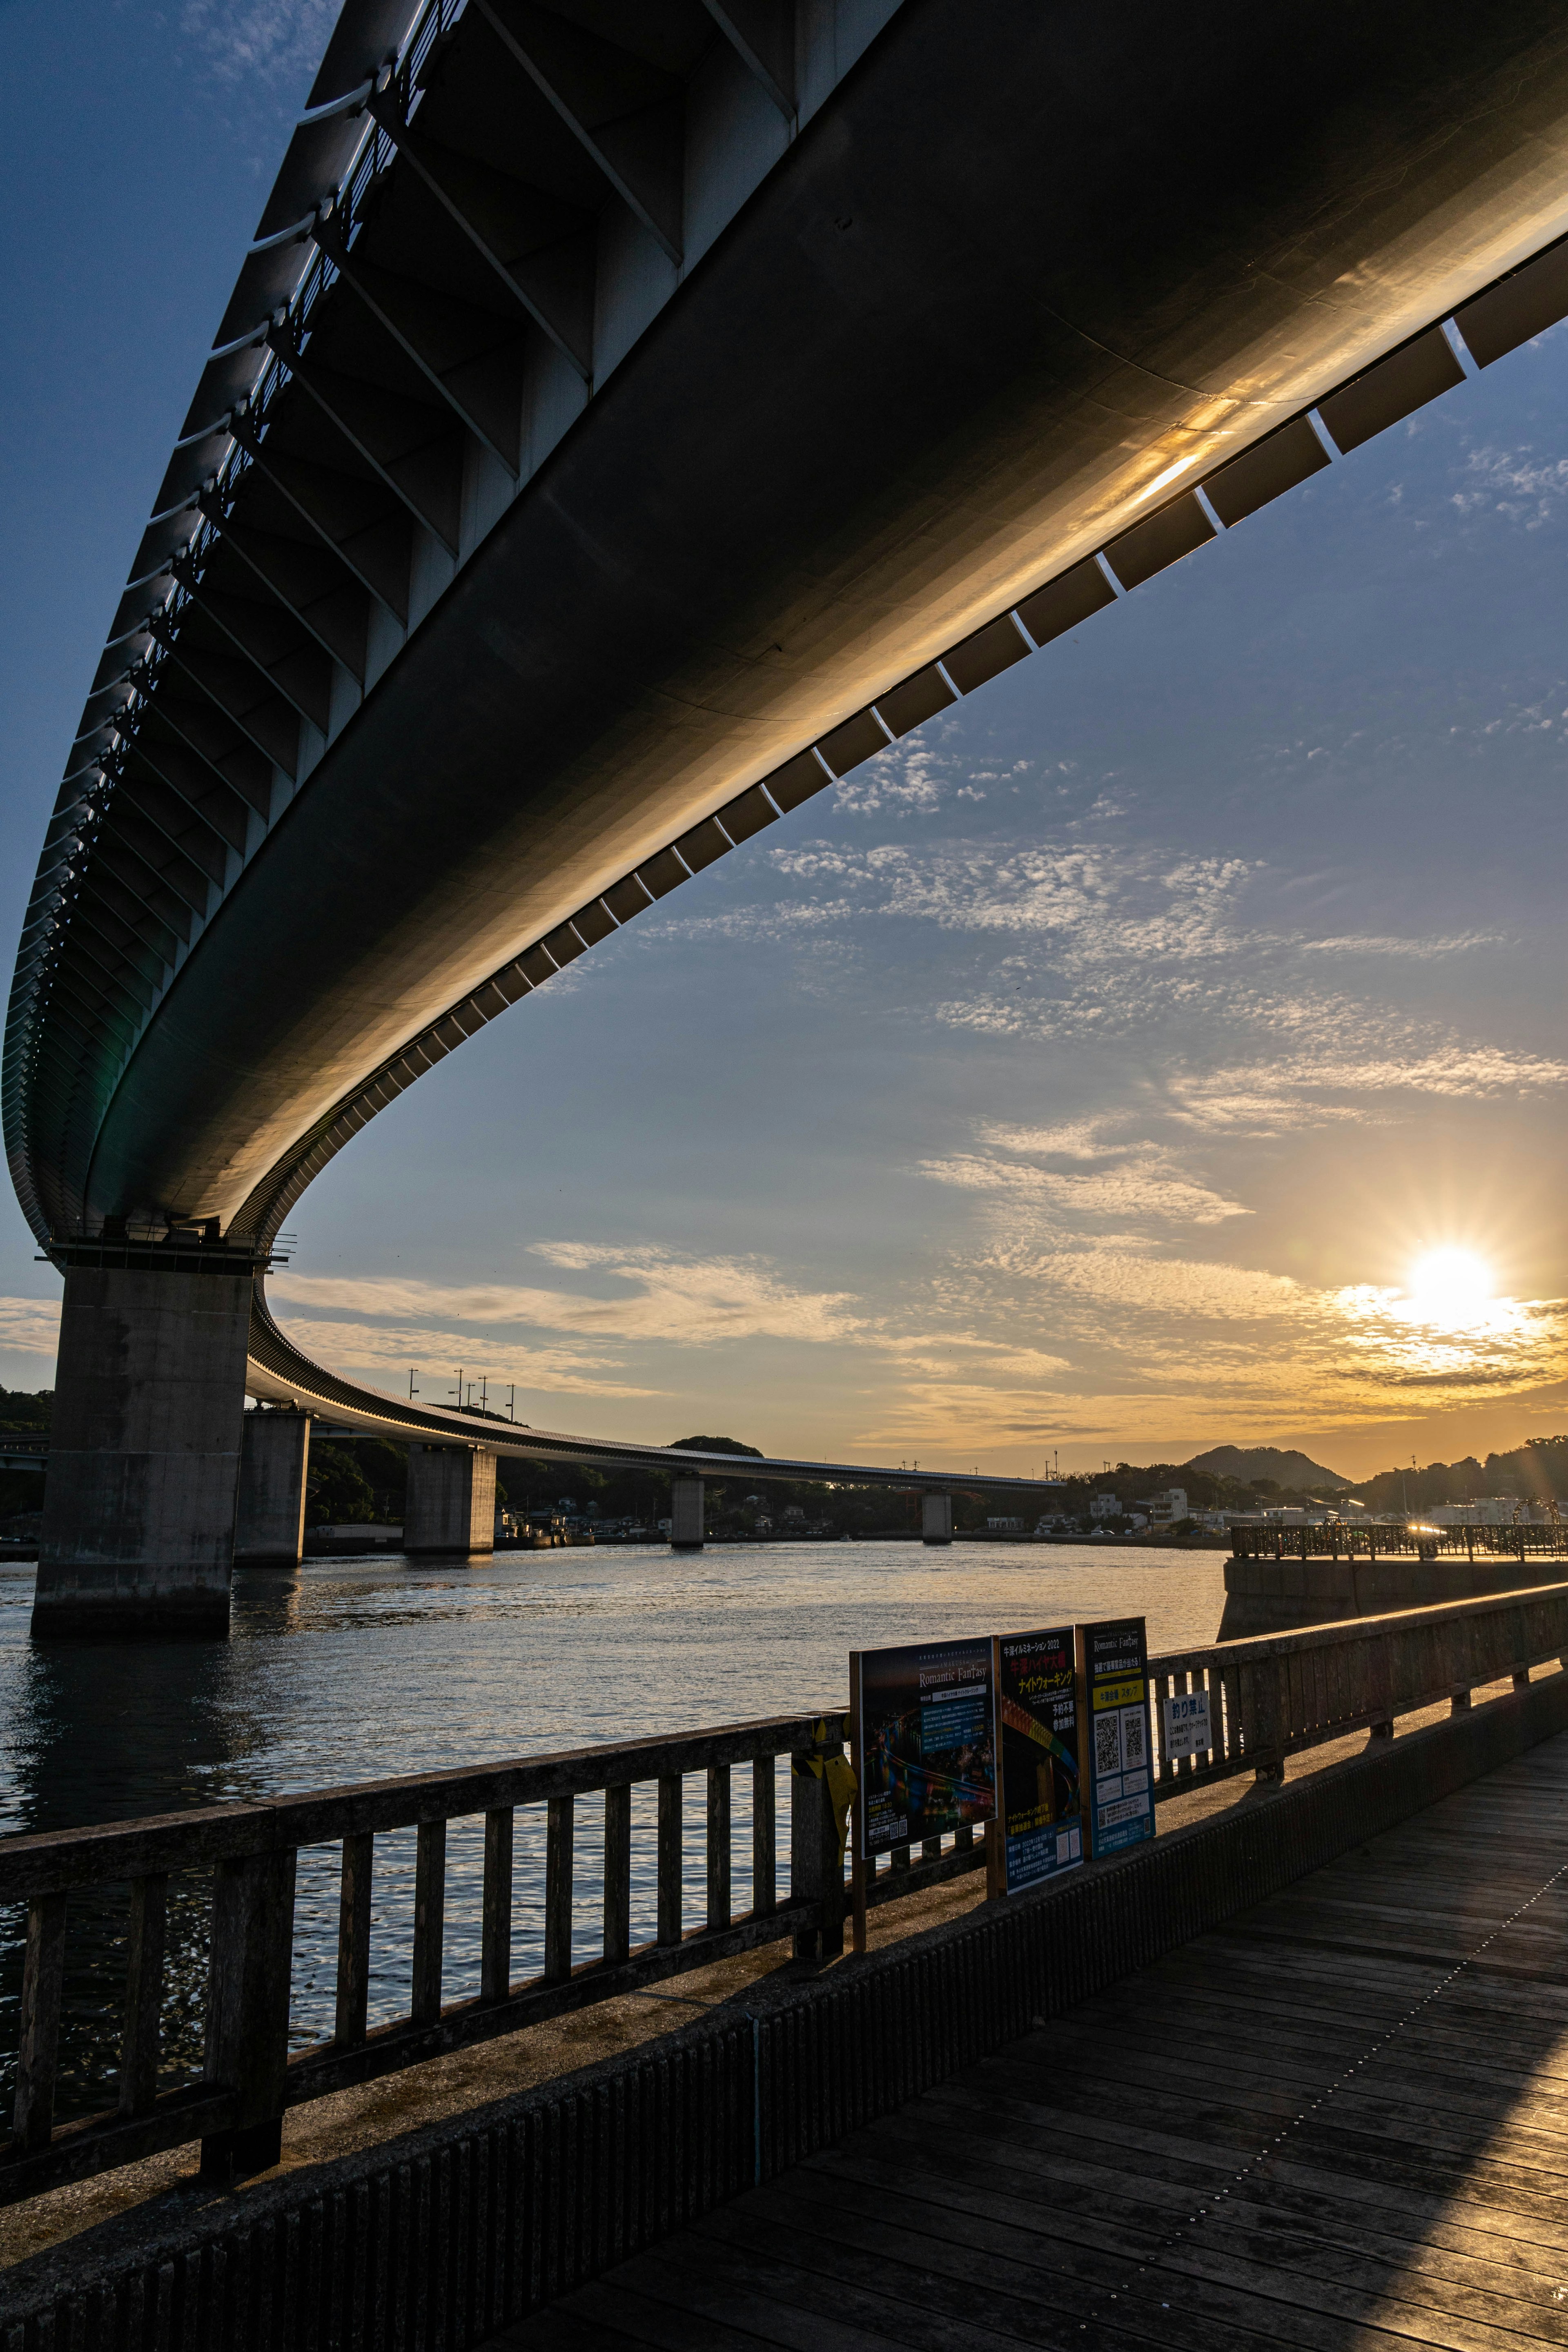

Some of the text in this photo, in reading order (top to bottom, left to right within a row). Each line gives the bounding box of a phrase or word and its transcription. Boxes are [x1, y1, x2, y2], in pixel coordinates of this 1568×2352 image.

[1004, 1639, 1060, 1657] 牛深イルミネーション 2022
[1094, 1635, 1138, 1652] Romantic Fantasy
[1010, 1651, 1065, 1677] 牛深ハイヤ大橋
[920, 1669, 955, 1688] Romantic
[958, 1664, 987, 1681] Fantasy
[1018, 1668, 1072, 1694] ナイトウォーキング
[1121, 1686, 1137, 1697] スタンプ
[1053, 1700, 1074, 1716] 予約不要
[1173, 1697, 1205, 1719] 釣り禁止
[1053, 1715, 1074, 1731] 参加無料
